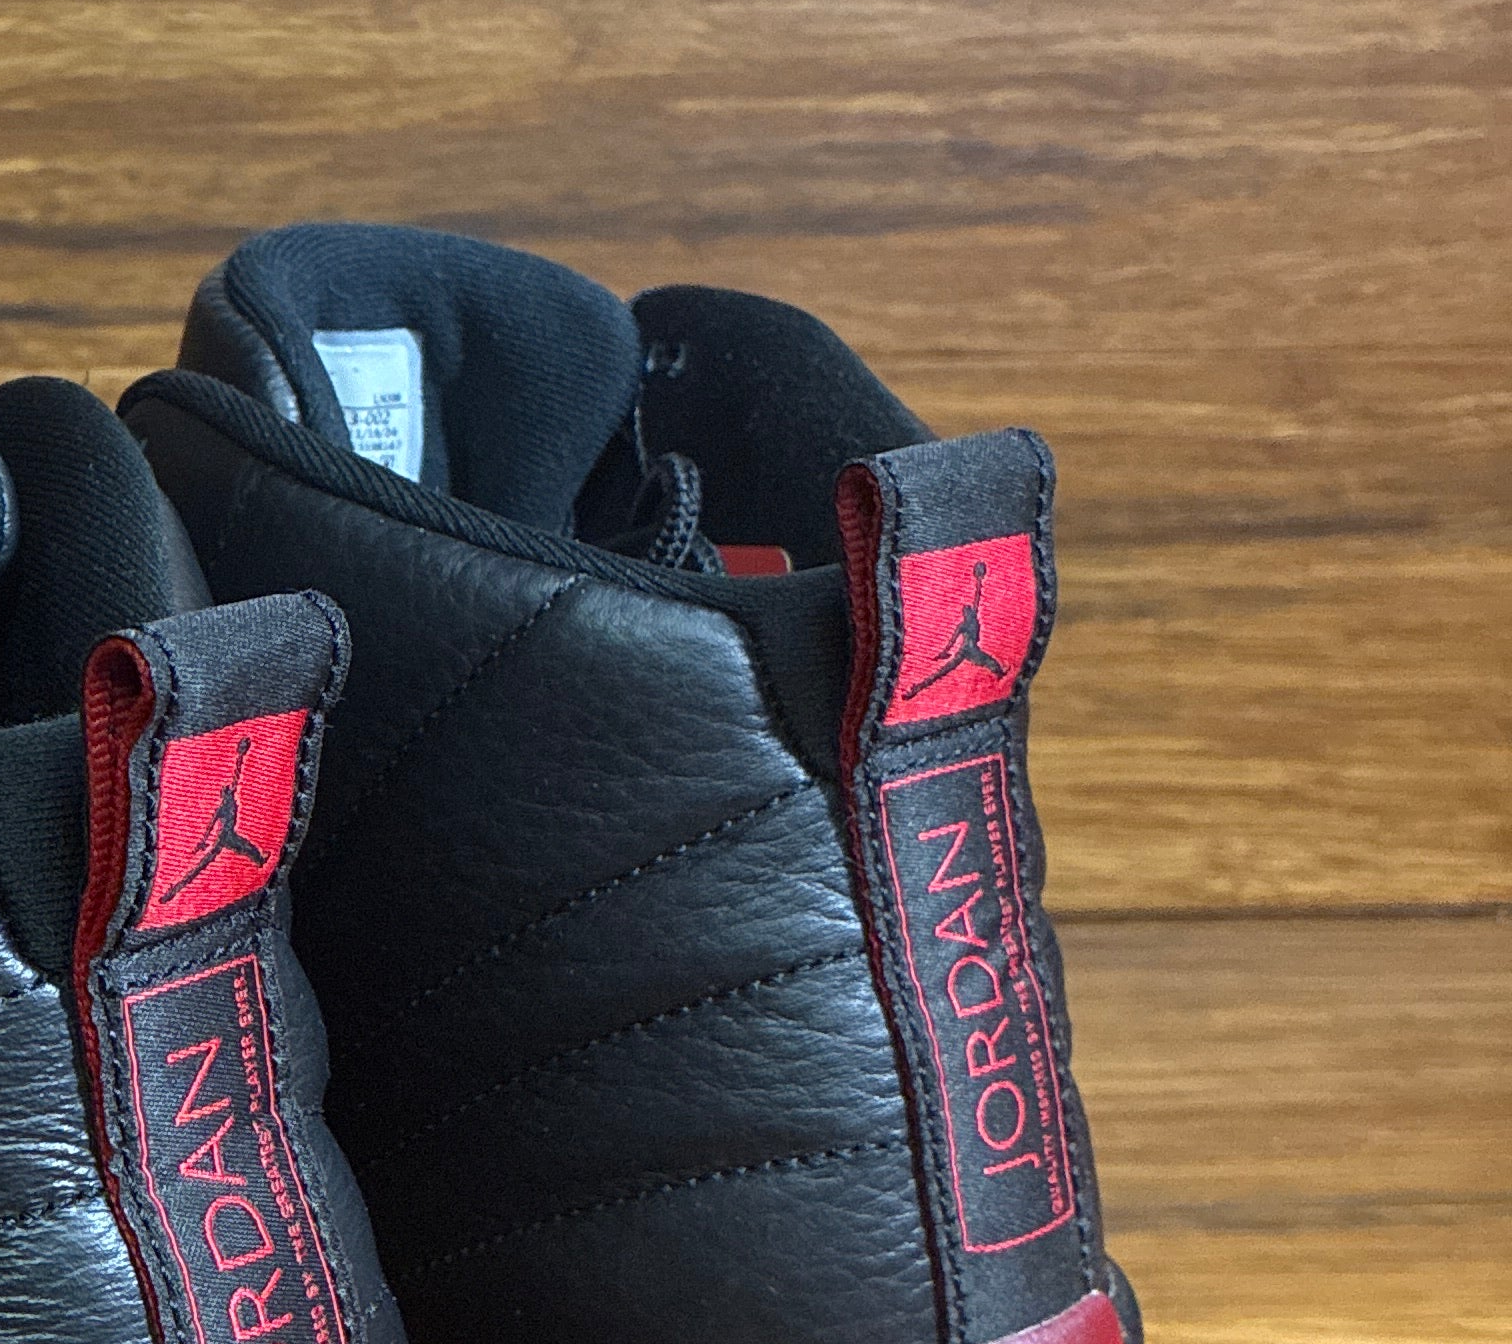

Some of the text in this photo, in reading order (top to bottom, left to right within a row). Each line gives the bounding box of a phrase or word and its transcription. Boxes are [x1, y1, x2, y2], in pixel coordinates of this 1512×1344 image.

[986, 819, 1007, 889] PLAYER
[917, 820, 1041, 1176] JORDAN
[239, 1031, 262, 1113] PLAYER
